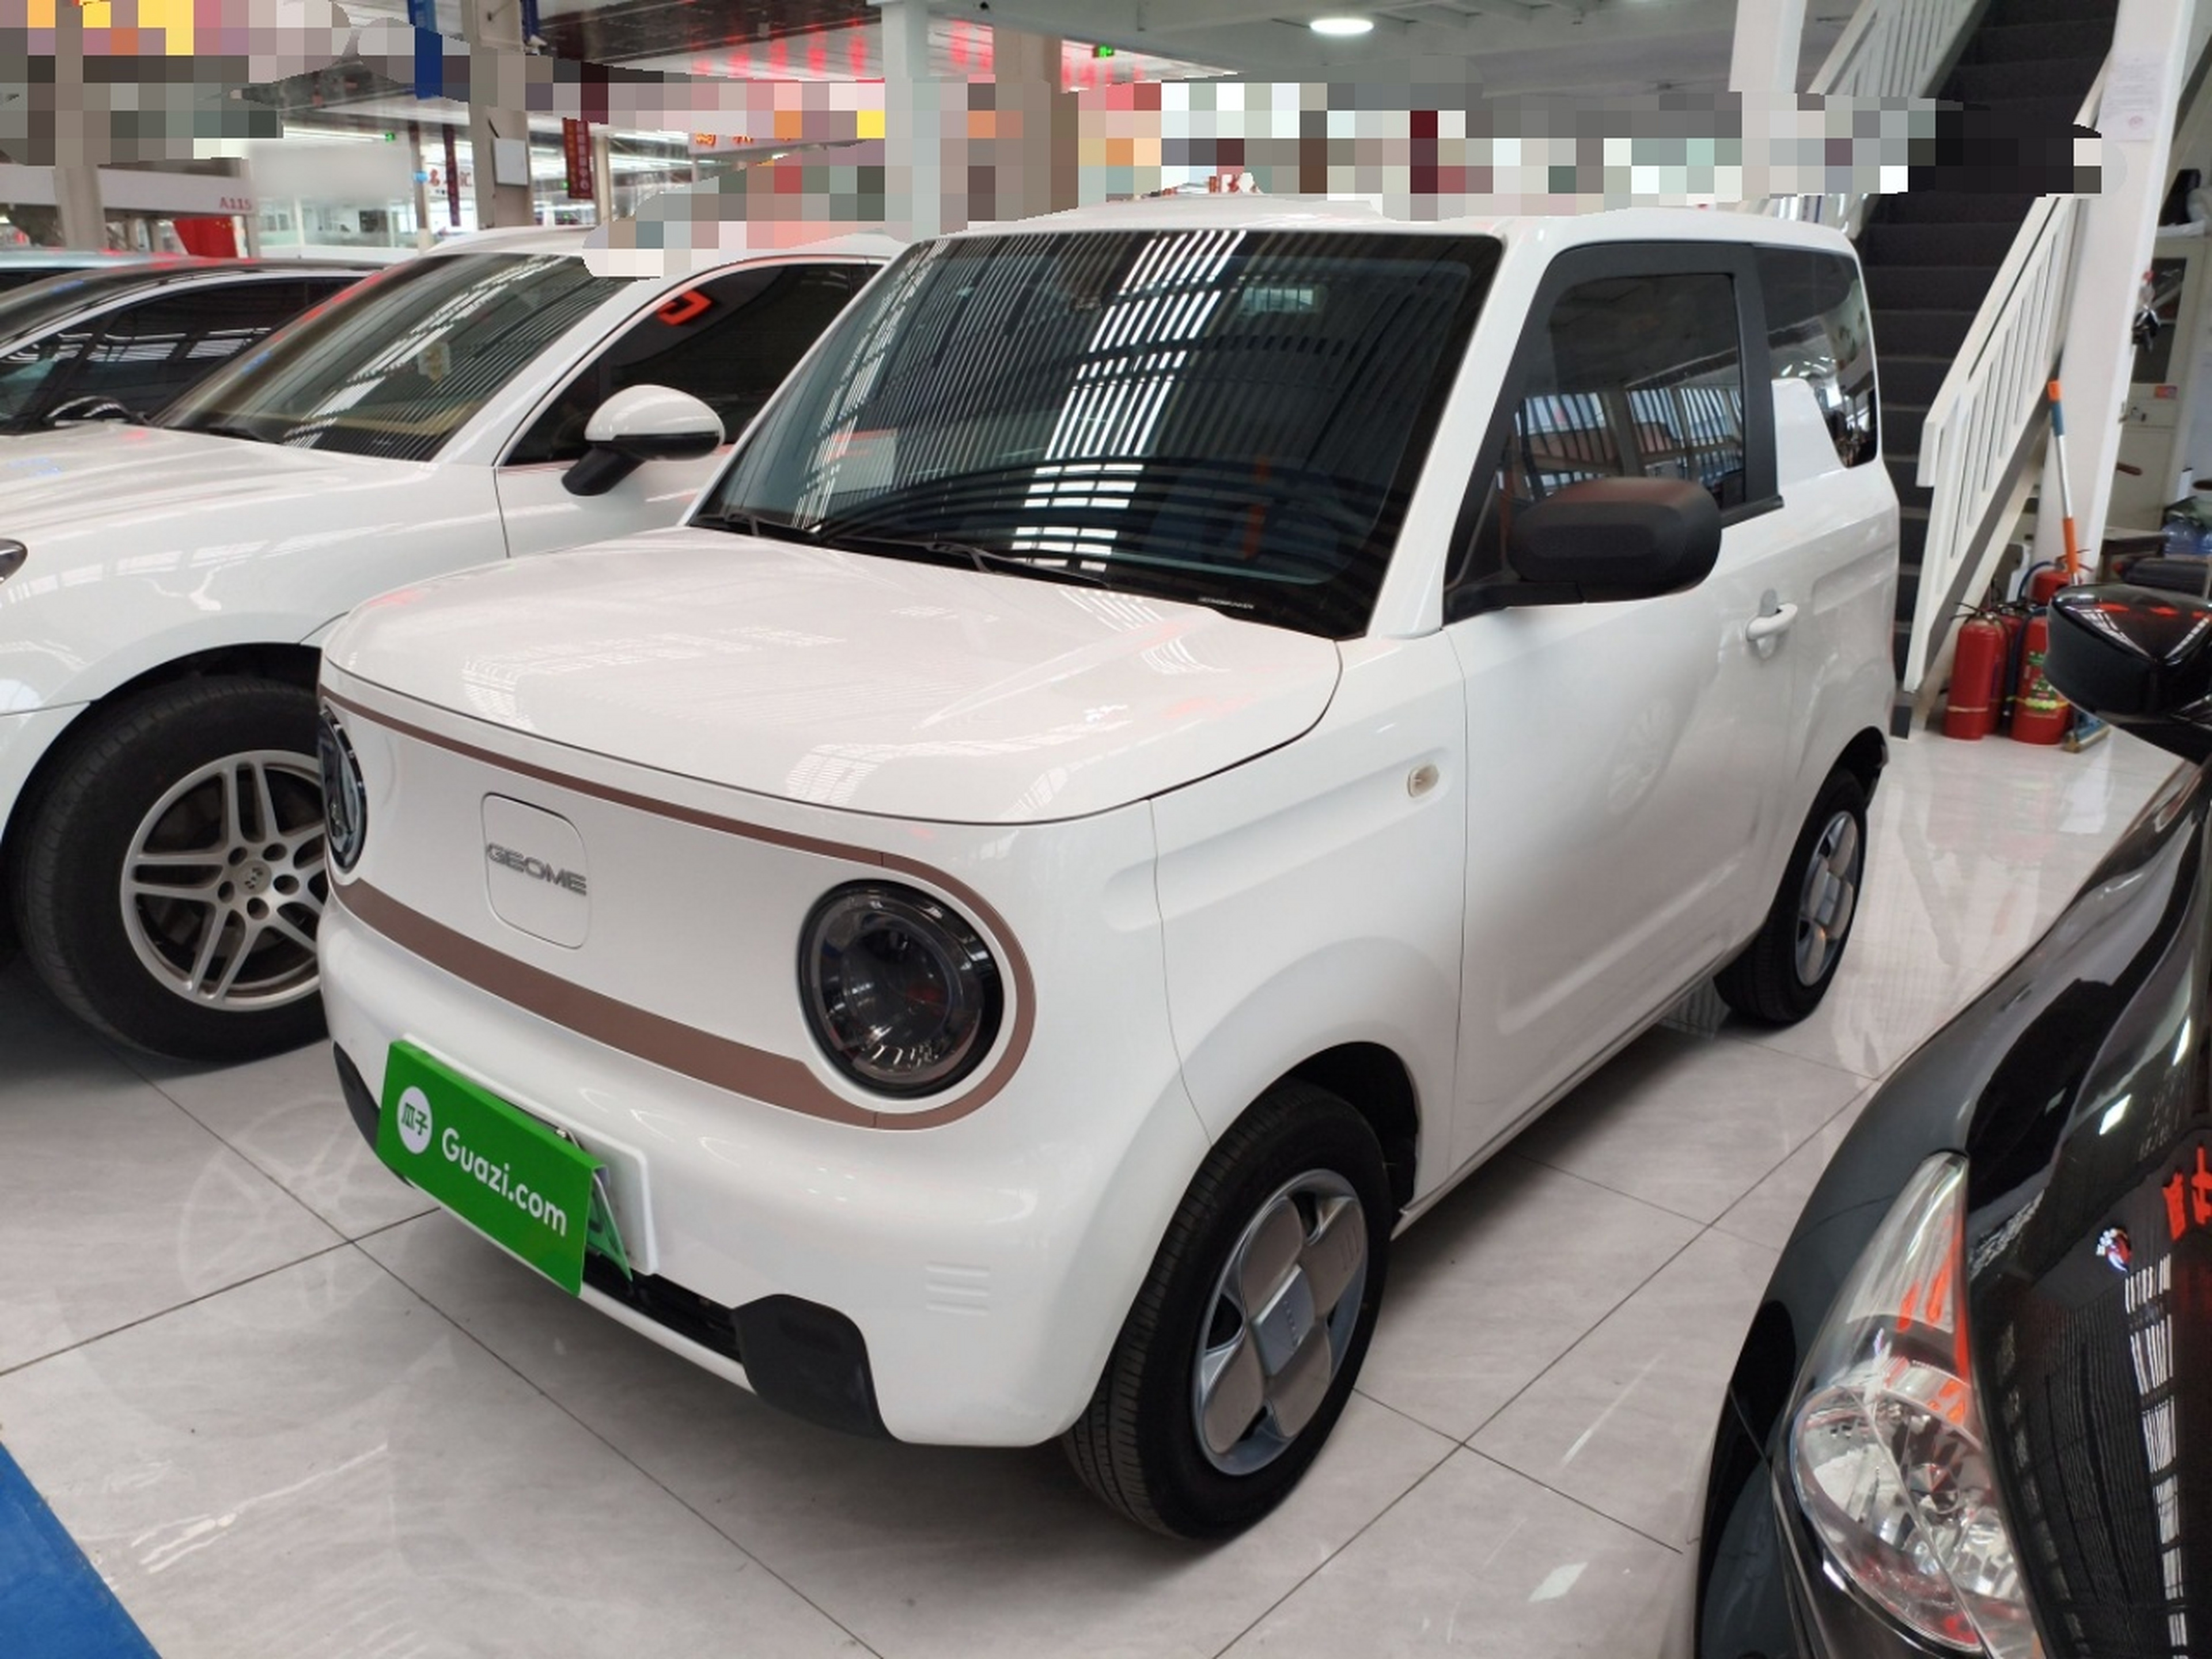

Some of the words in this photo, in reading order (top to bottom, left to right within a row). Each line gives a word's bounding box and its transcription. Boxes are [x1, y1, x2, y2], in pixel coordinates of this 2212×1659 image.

[486, 843, 587, 896] GEOME
[401, 1102, 429, 1137] 瓜子
[442, 1127, 567, 1237] Guazi.com
